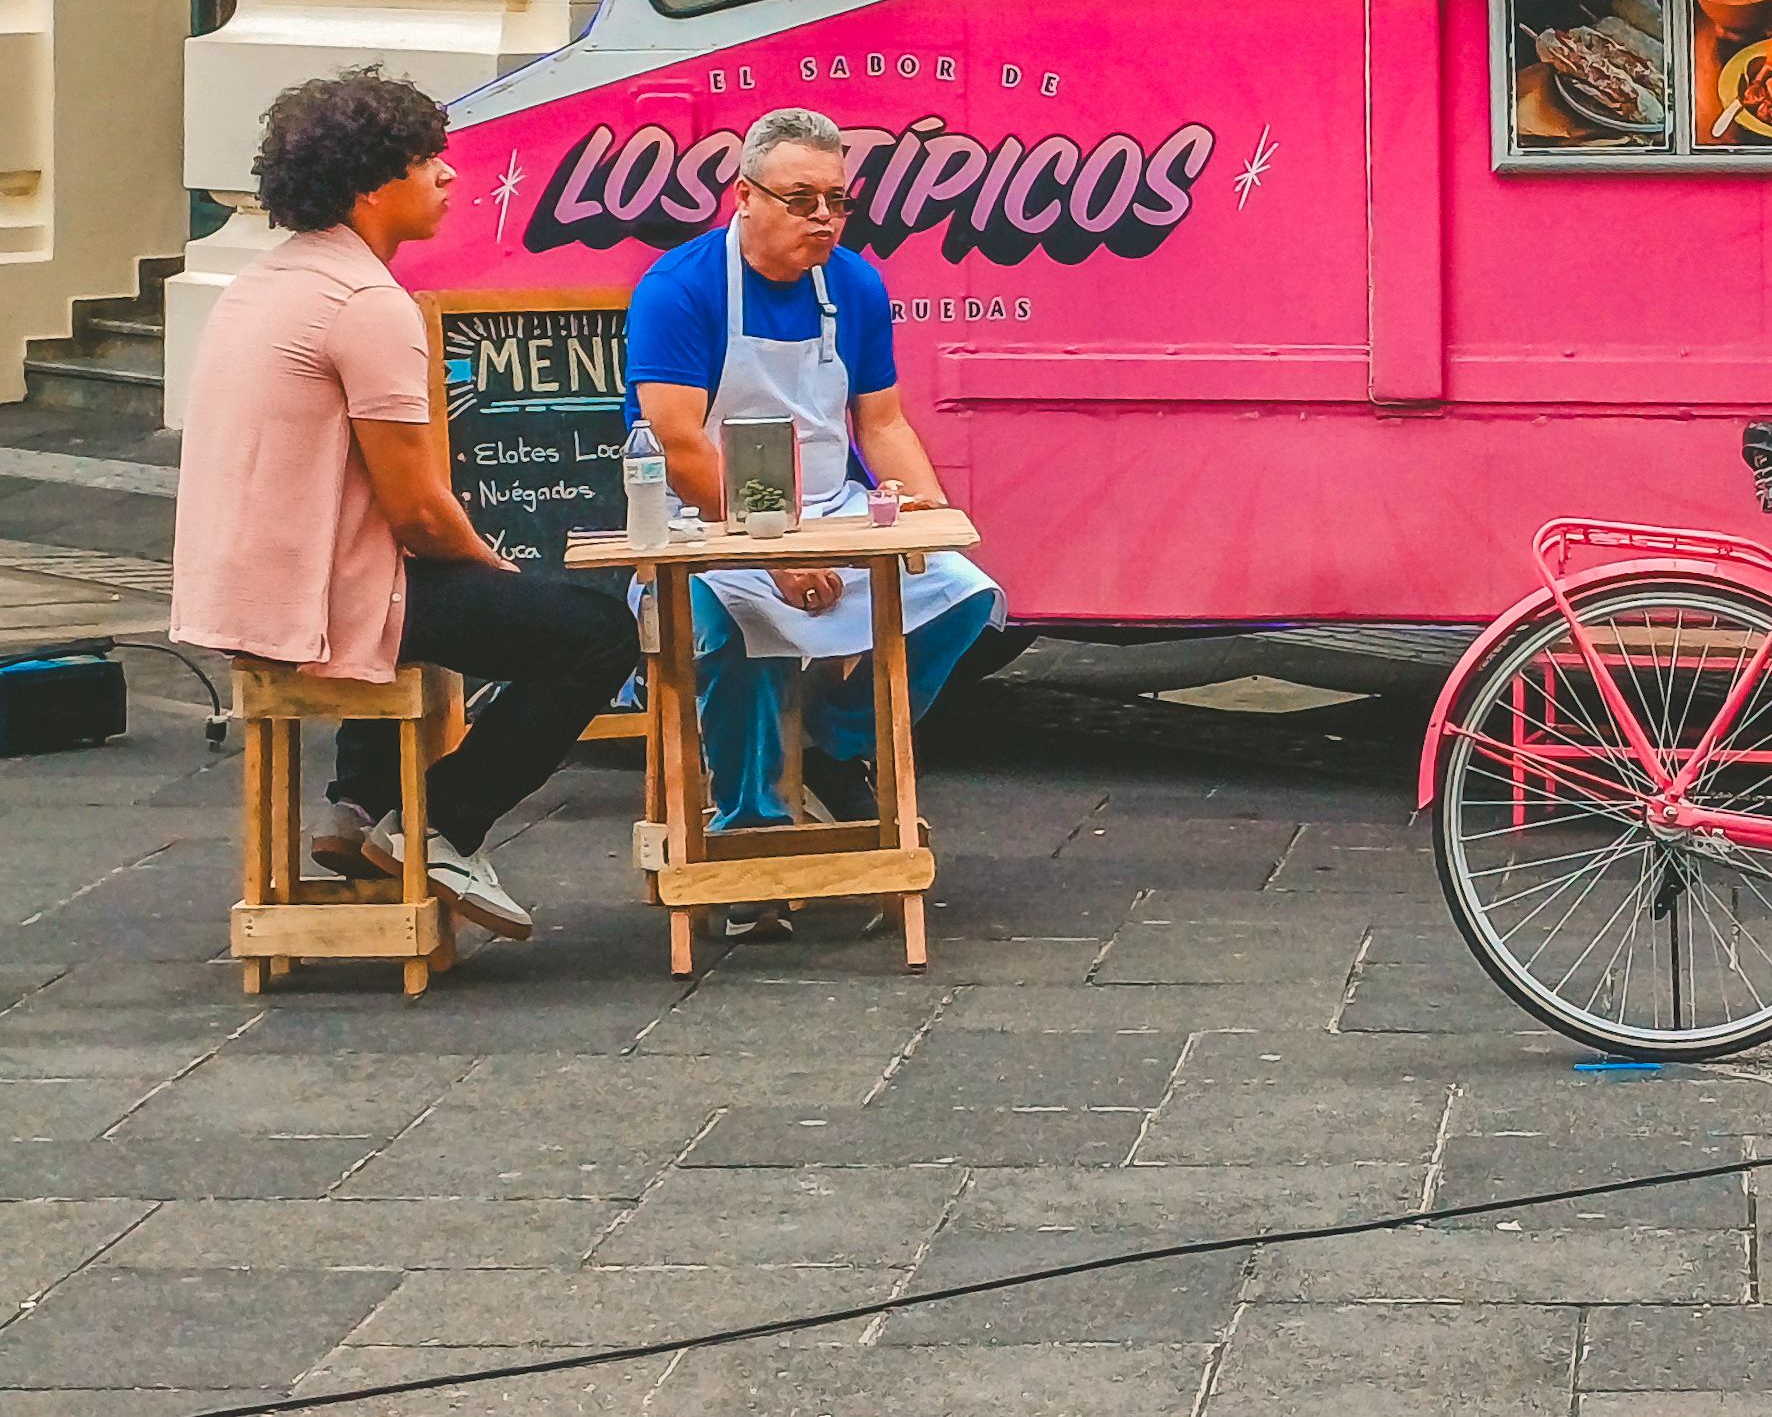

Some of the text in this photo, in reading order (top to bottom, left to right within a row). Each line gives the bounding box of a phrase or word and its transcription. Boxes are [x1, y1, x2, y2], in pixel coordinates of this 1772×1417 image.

[709, 53, 1060, 97] EL SABOR DE
[538, 115, 1216, 251] LOS TÍPICOS
[890, 296, 1032, 324] RUEDAS
[474, 436, 560, 466] Elotes
[479, 479, 597, 513] Nuégados
[484, 529, 542, 560] Yuca
